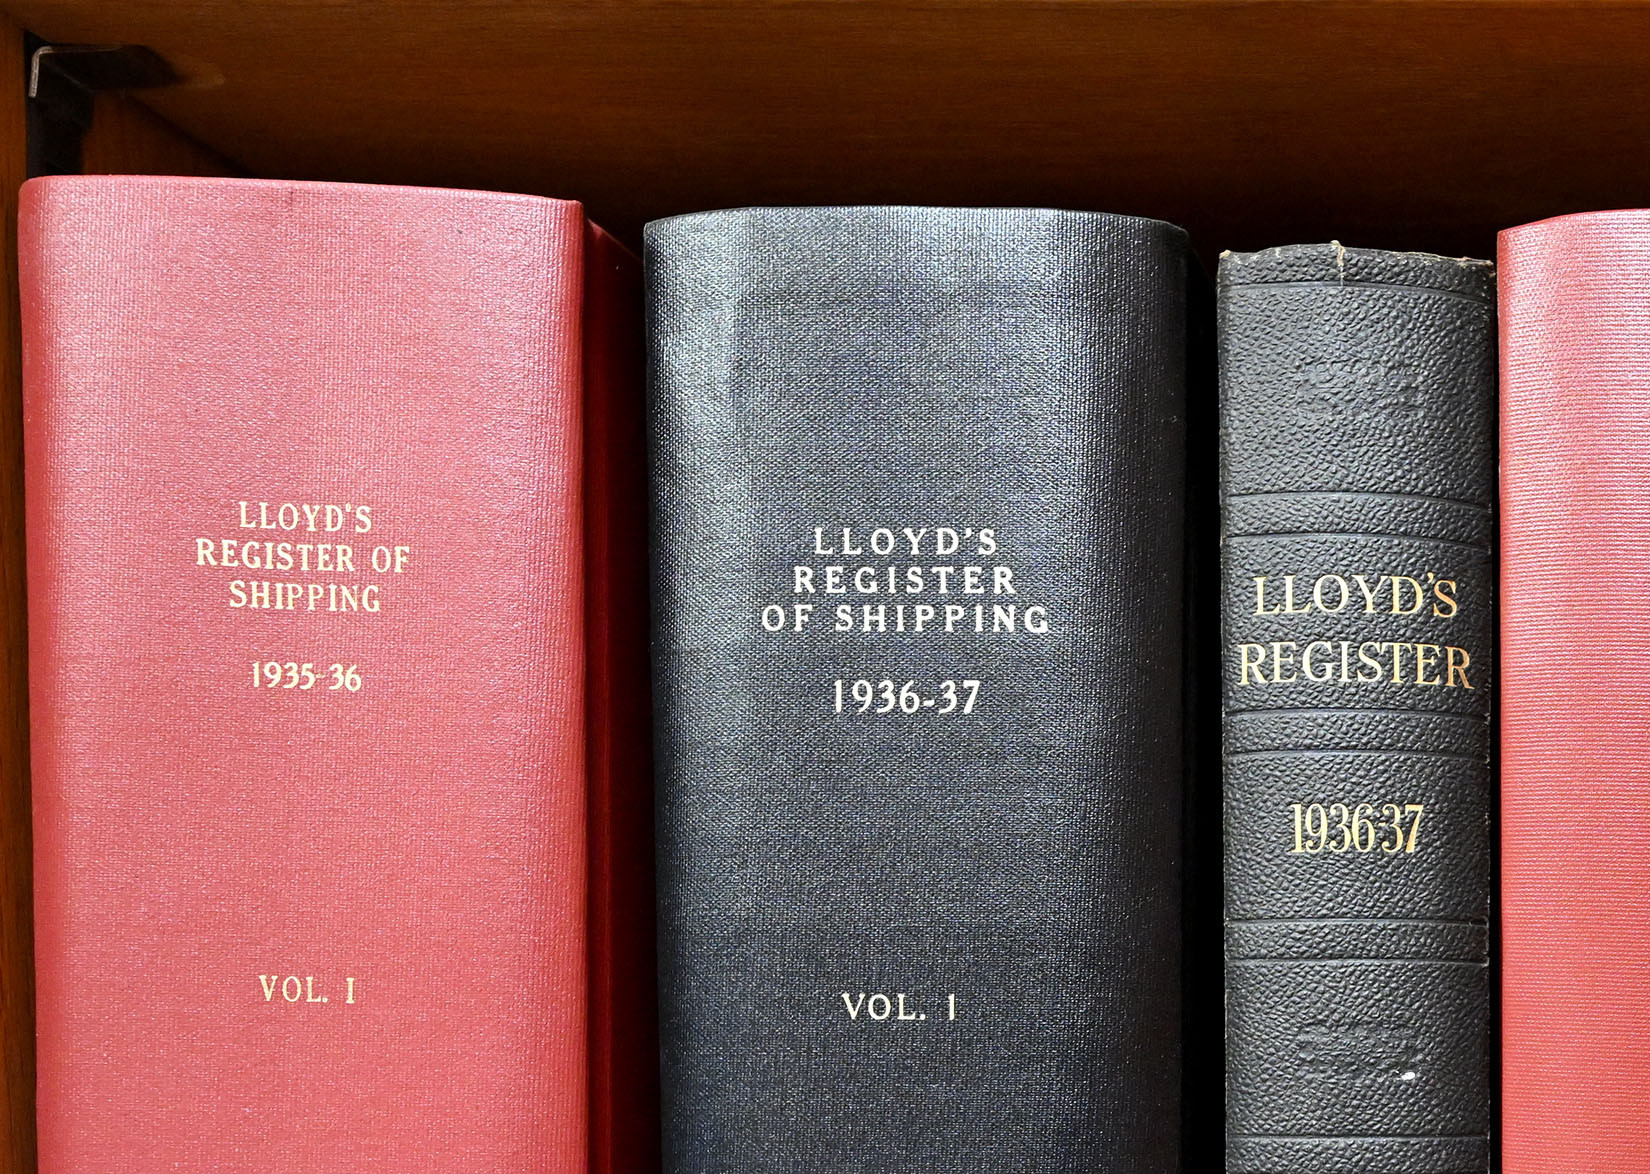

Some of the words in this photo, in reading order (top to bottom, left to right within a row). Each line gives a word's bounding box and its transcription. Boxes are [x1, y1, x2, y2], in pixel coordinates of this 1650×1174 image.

[237, 500, 373, 534] LLOYD'S
[195, 537, 353, 574] REGISTER
[370, 543, 411, 575] OF
[813, 526, 997, 558] LLOYD'S
[229, 579, 382, 614] SHIPPING
[792, 565, 1017, 597] REGISTER
[1252, 572, 1459, 621] LLOYD'S
[760, 604, 813, 635] OF
[834, 603, 1049, 636] SHIPPING
[250, 660, 363, 693] 1935-36
[1237, 641, 1474, 691] REGISTER
[831, 678, 982, 716] 1936-37
[1288, 803, 1425, 855] 1936-37
[257, 974, 330, 1006] VOL.
[345, 976, 356, 1006] I
[840, 991, 927, 1023] VOL.
